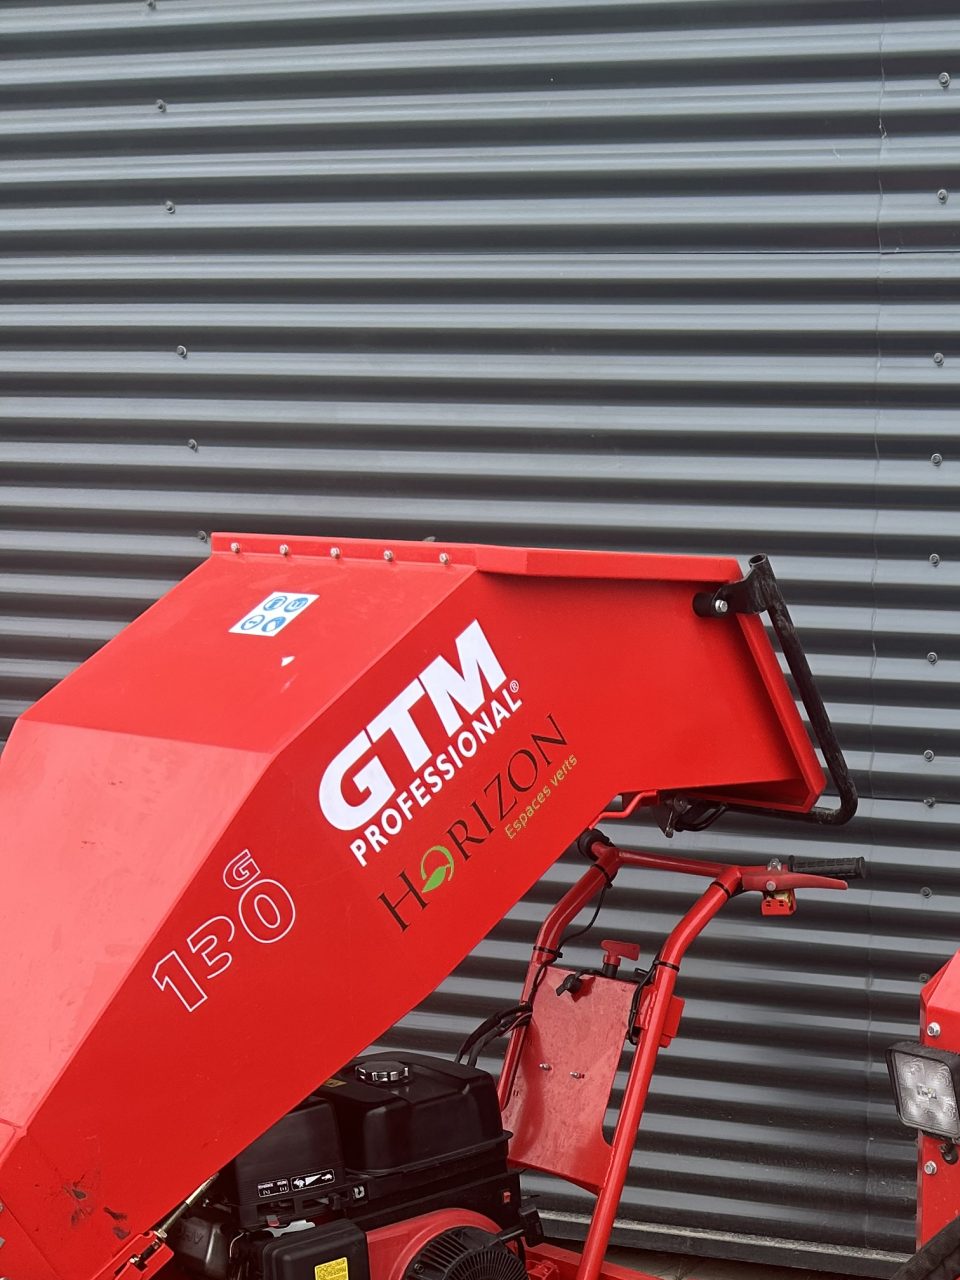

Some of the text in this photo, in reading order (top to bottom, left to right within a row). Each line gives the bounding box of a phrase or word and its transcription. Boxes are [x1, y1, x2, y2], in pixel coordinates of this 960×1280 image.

[318, 619, 507, 831] GTM
[377, 714, 568, 933] HORIZON
[504, 753, 578, 839] Espaces verts
[222, 850, 261, 890] G
[151, 879, 296, 1012] 130
